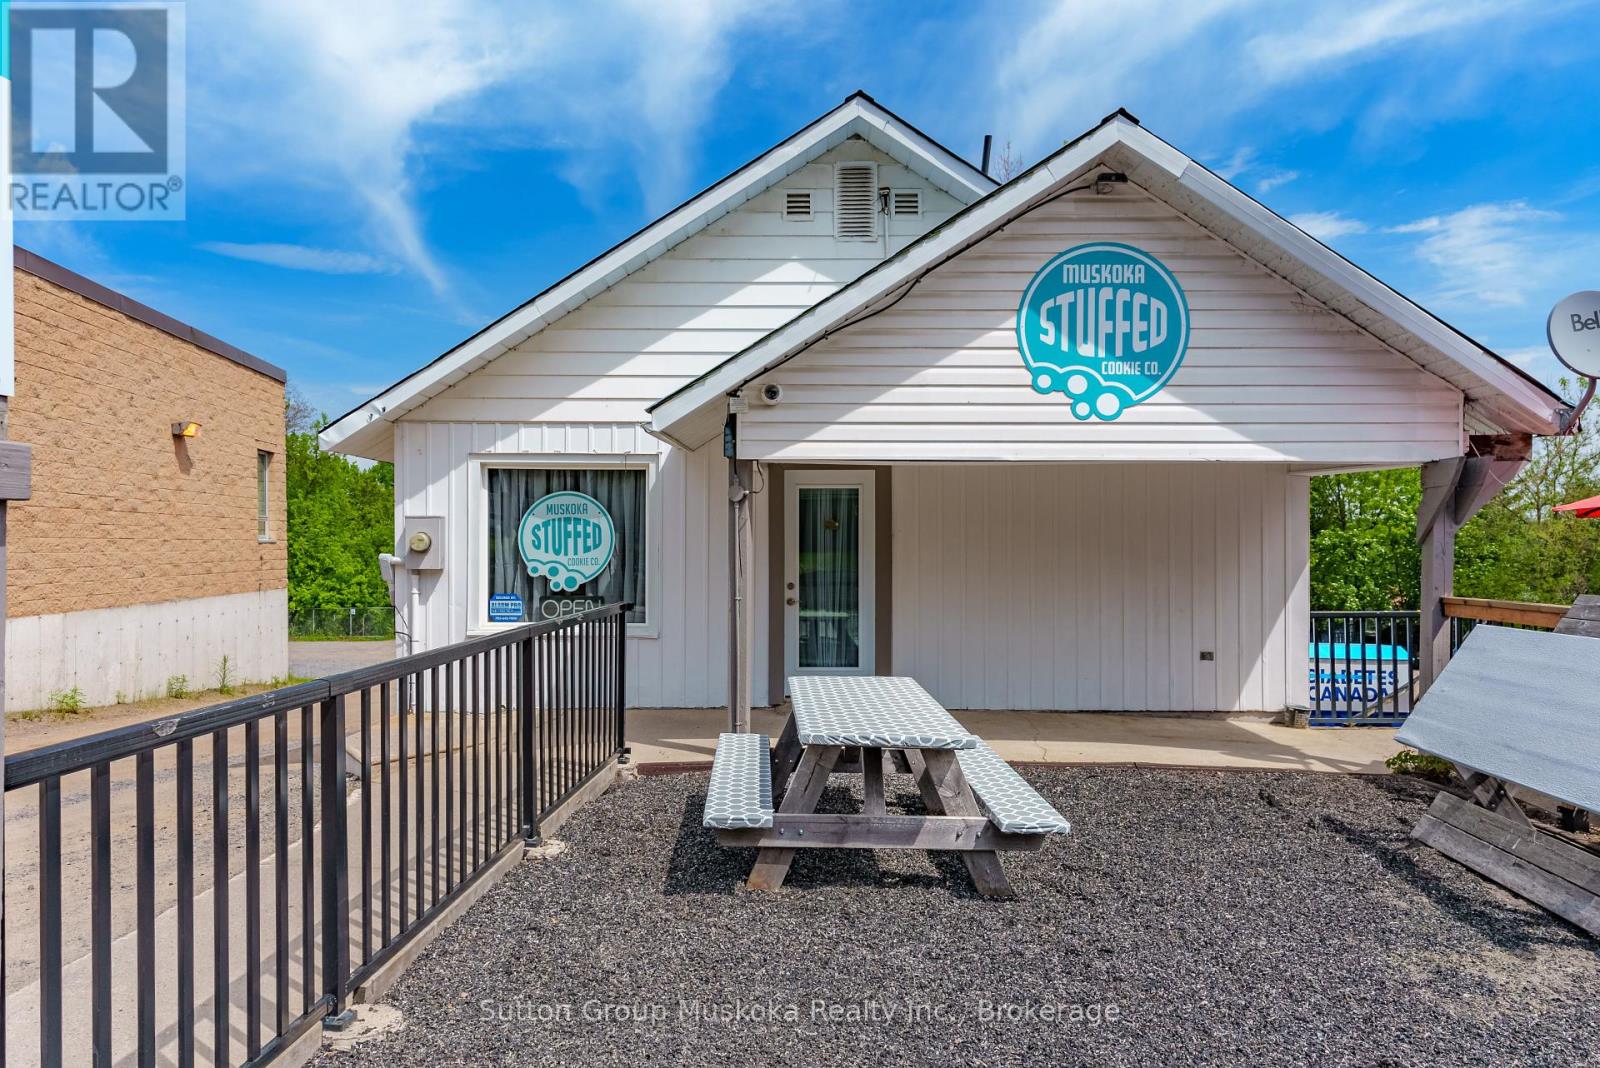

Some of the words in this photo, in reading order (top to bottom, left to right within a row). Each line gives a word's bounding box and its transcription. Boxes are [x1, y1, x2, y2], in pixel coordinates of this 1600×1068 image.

[1063, 264, 1145, 284] MUSKOKA
[1040, 287, 1168, 358] STUFFED
[1570, 309, 1600, 332] Bel
[1101, 361, 1141, 376] COOKIE
[1144, 361, 1162, 376] CO.
[546, 503, 588, 516] MUSKOKA
[531, 516, 602, 557] STUFFED
[567, 557, 588, 567] COOKIE
